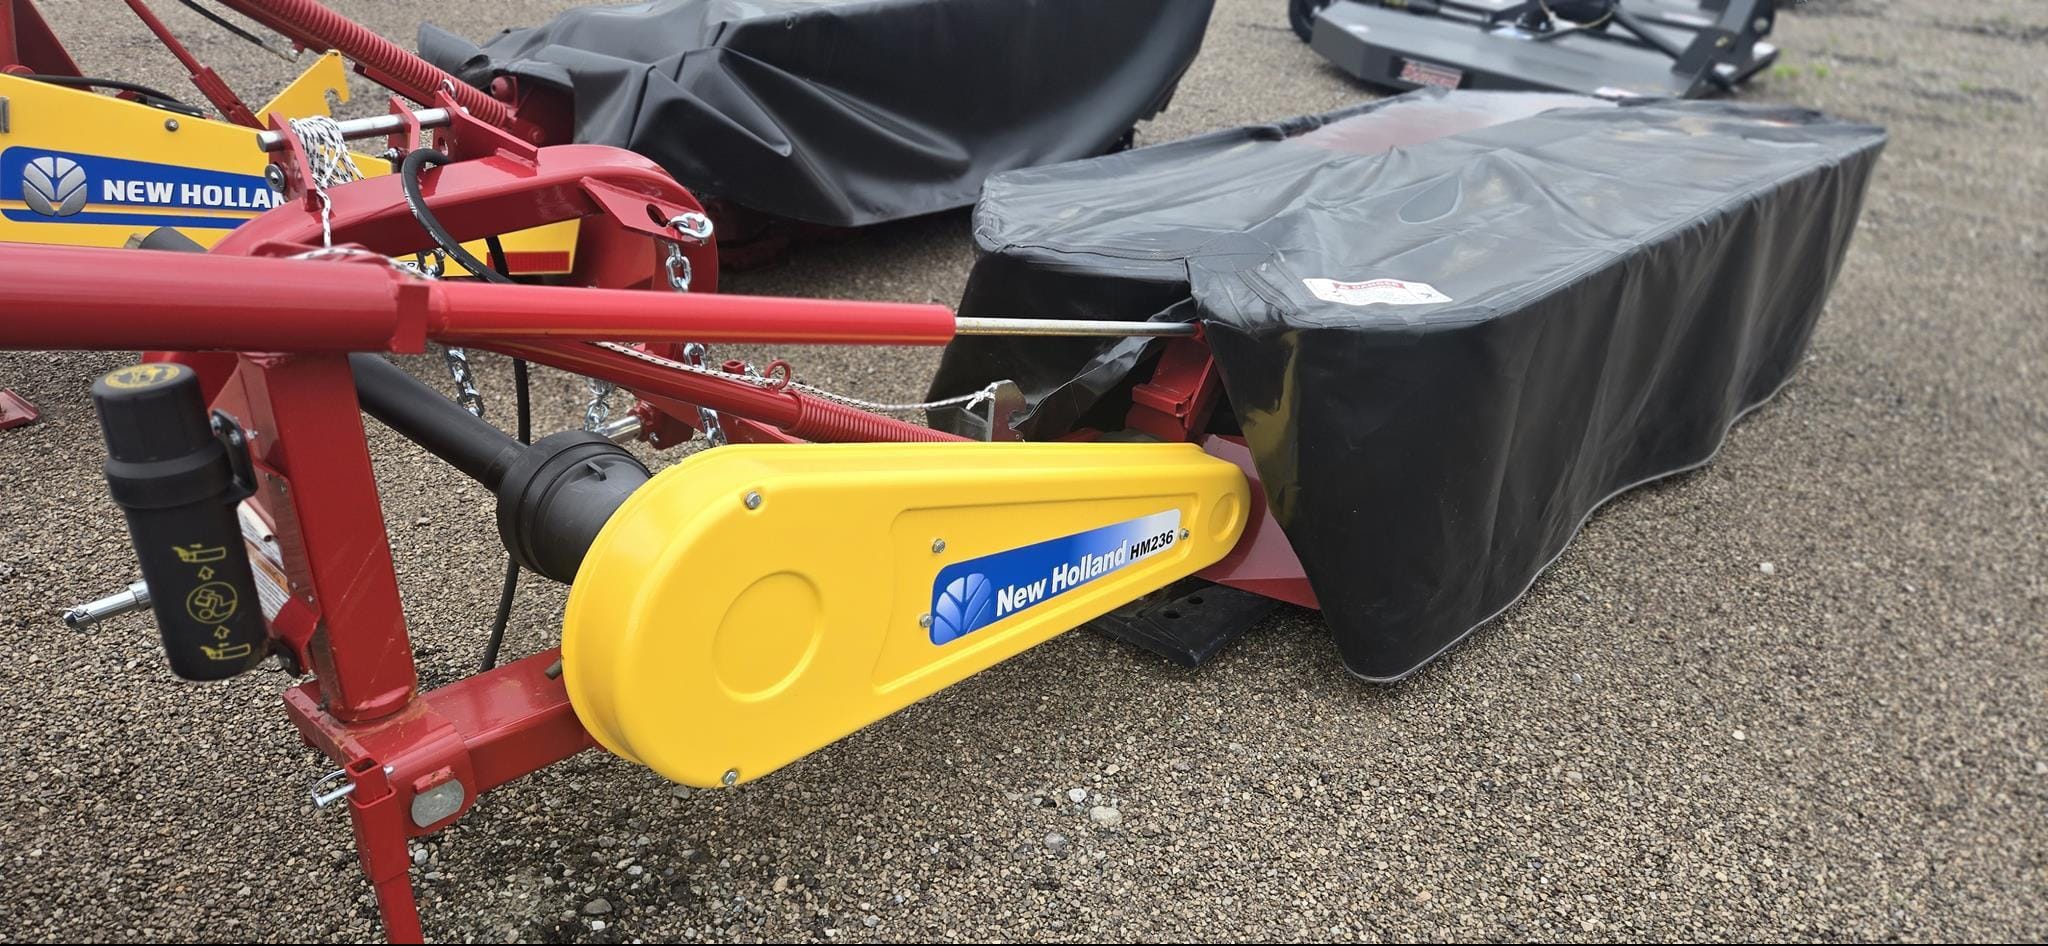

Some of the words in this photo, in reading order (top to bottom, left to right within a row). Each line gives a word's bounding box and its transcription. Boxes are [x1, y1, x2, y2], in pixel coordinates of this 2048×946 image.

[103, 179, 174, 203] NEW
[996, 578, 1047, 616] New
[1051, 540, 1127, 593] Holland
[1129, 530, 1174, 560] HM236
